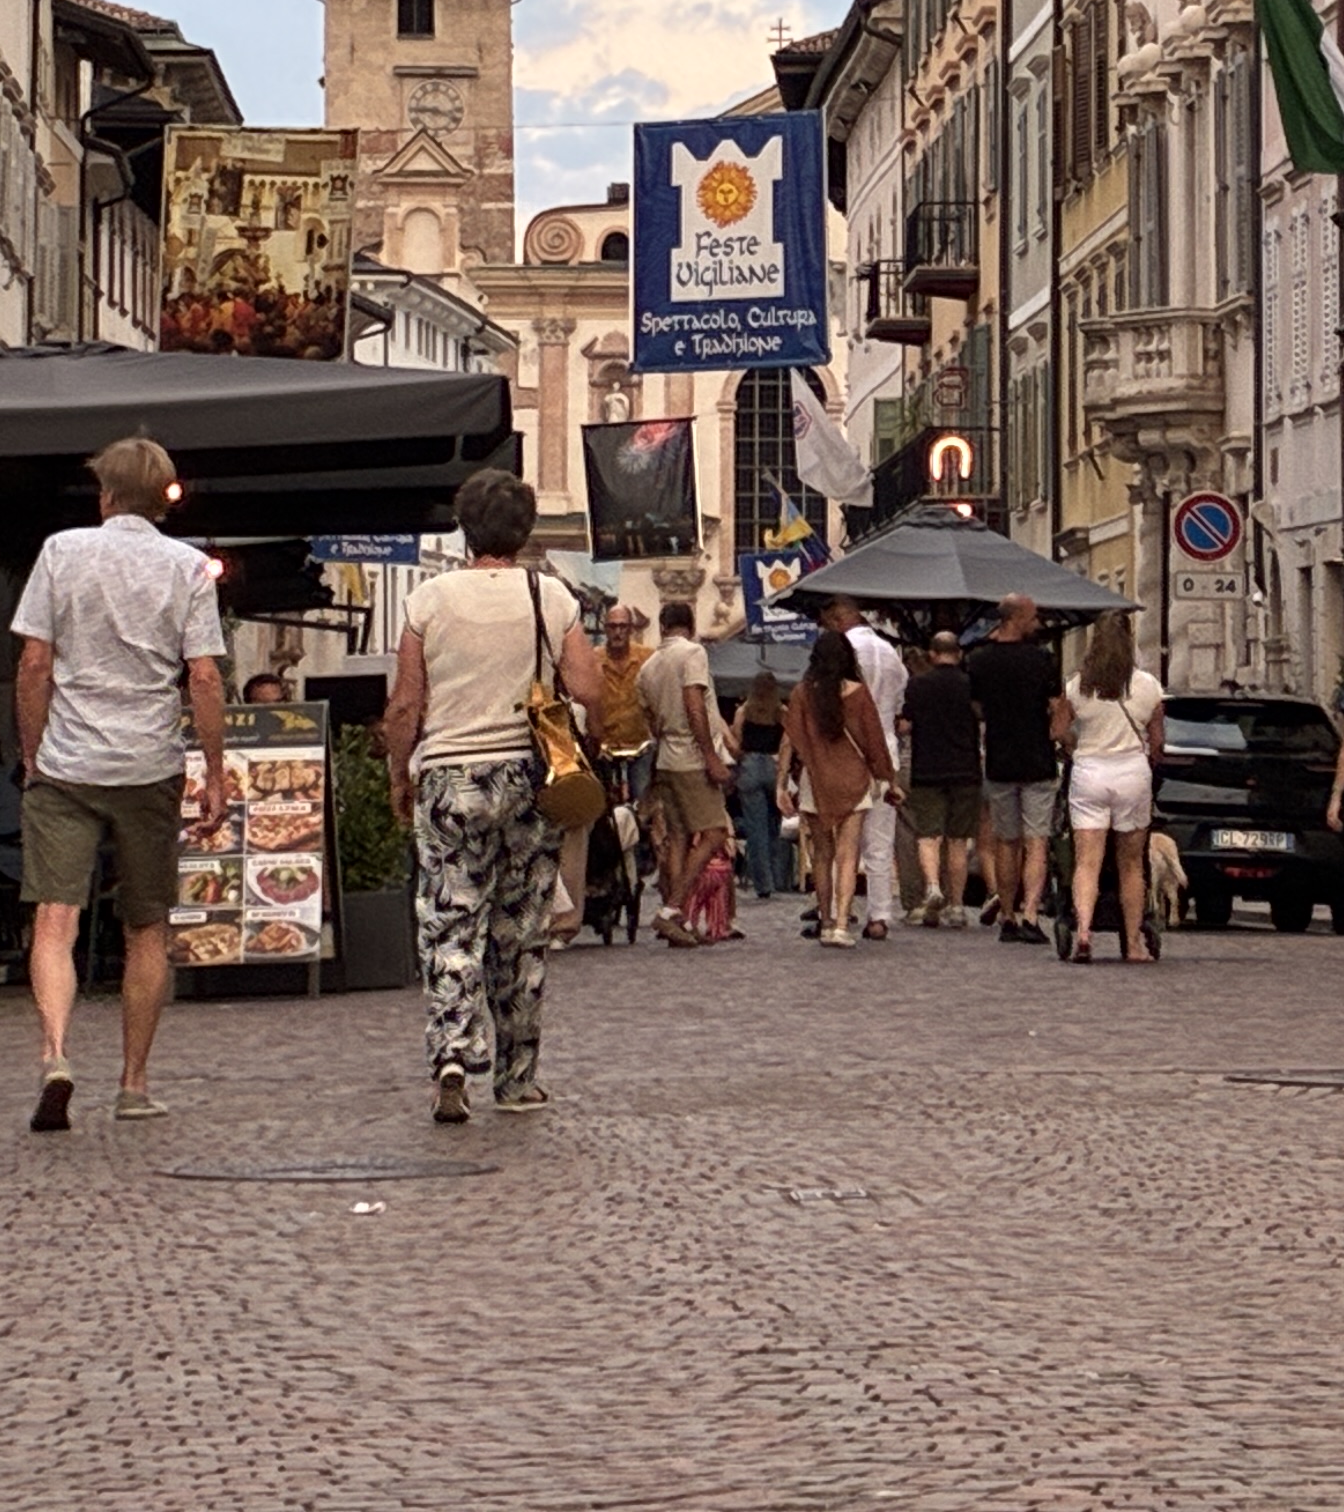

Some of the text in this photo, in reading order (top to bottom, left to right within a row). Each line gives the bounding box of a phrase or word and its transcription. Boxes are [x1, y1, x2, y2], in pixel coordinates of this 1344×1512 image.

[695, 231, 762, 258] Feste
[675, 260, 780, 297] Vigiliane
[747, 306, 817, 331] Cultura
[674, 340, 688, 356] e
[1214, 579, 1236, 593] 24
